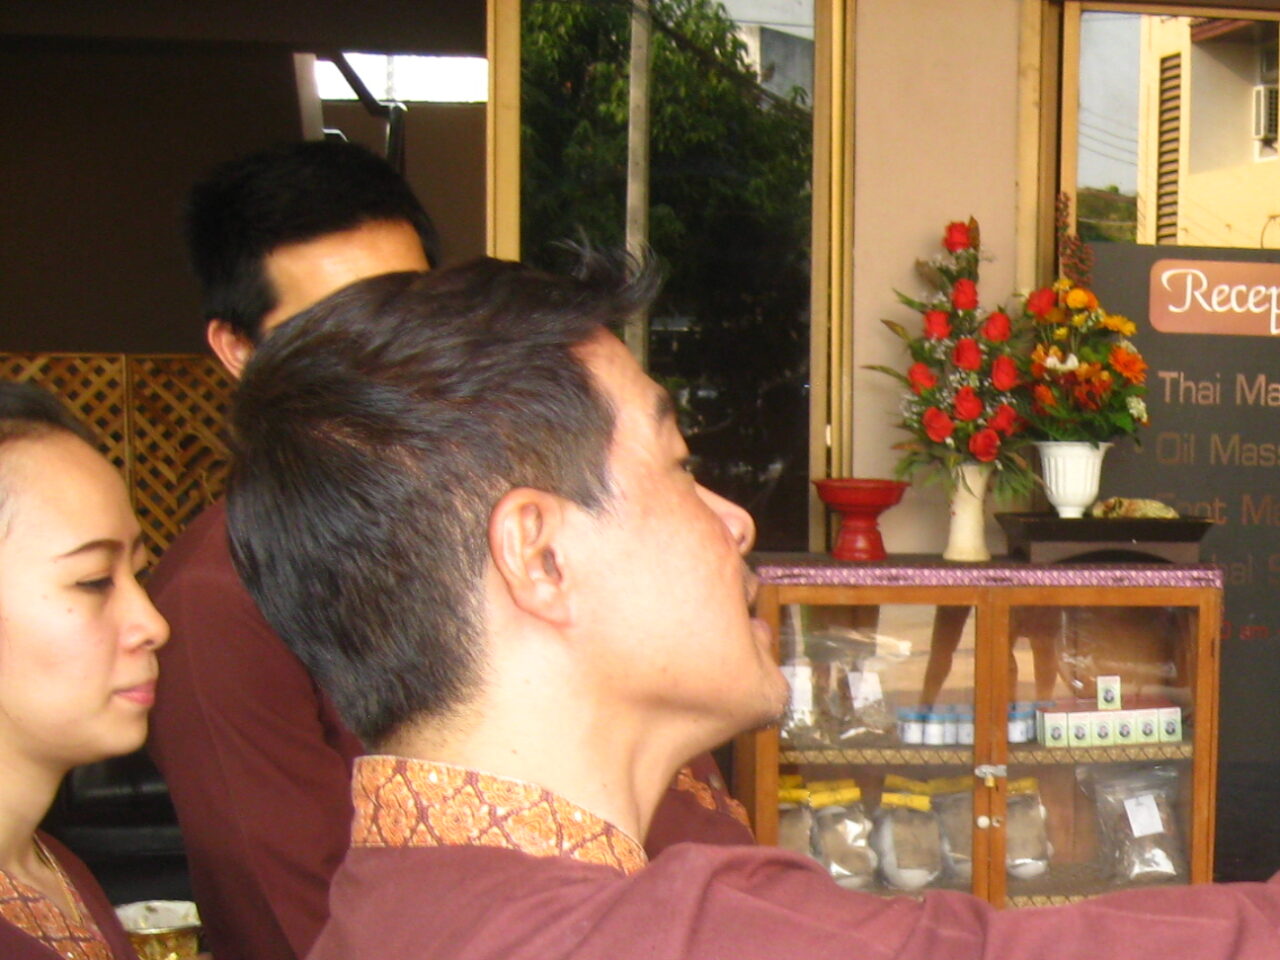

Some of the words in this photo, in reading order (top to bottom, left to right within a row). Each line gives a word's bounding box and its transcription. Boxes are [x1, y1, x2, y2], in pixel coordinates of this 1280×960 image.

[1157, 371, 1221, 405] Thai
[1156, 432, 1195, 467] Oil
[1154, 493, 1228, 525] oot
[1239, 624, 1269, 640] am
